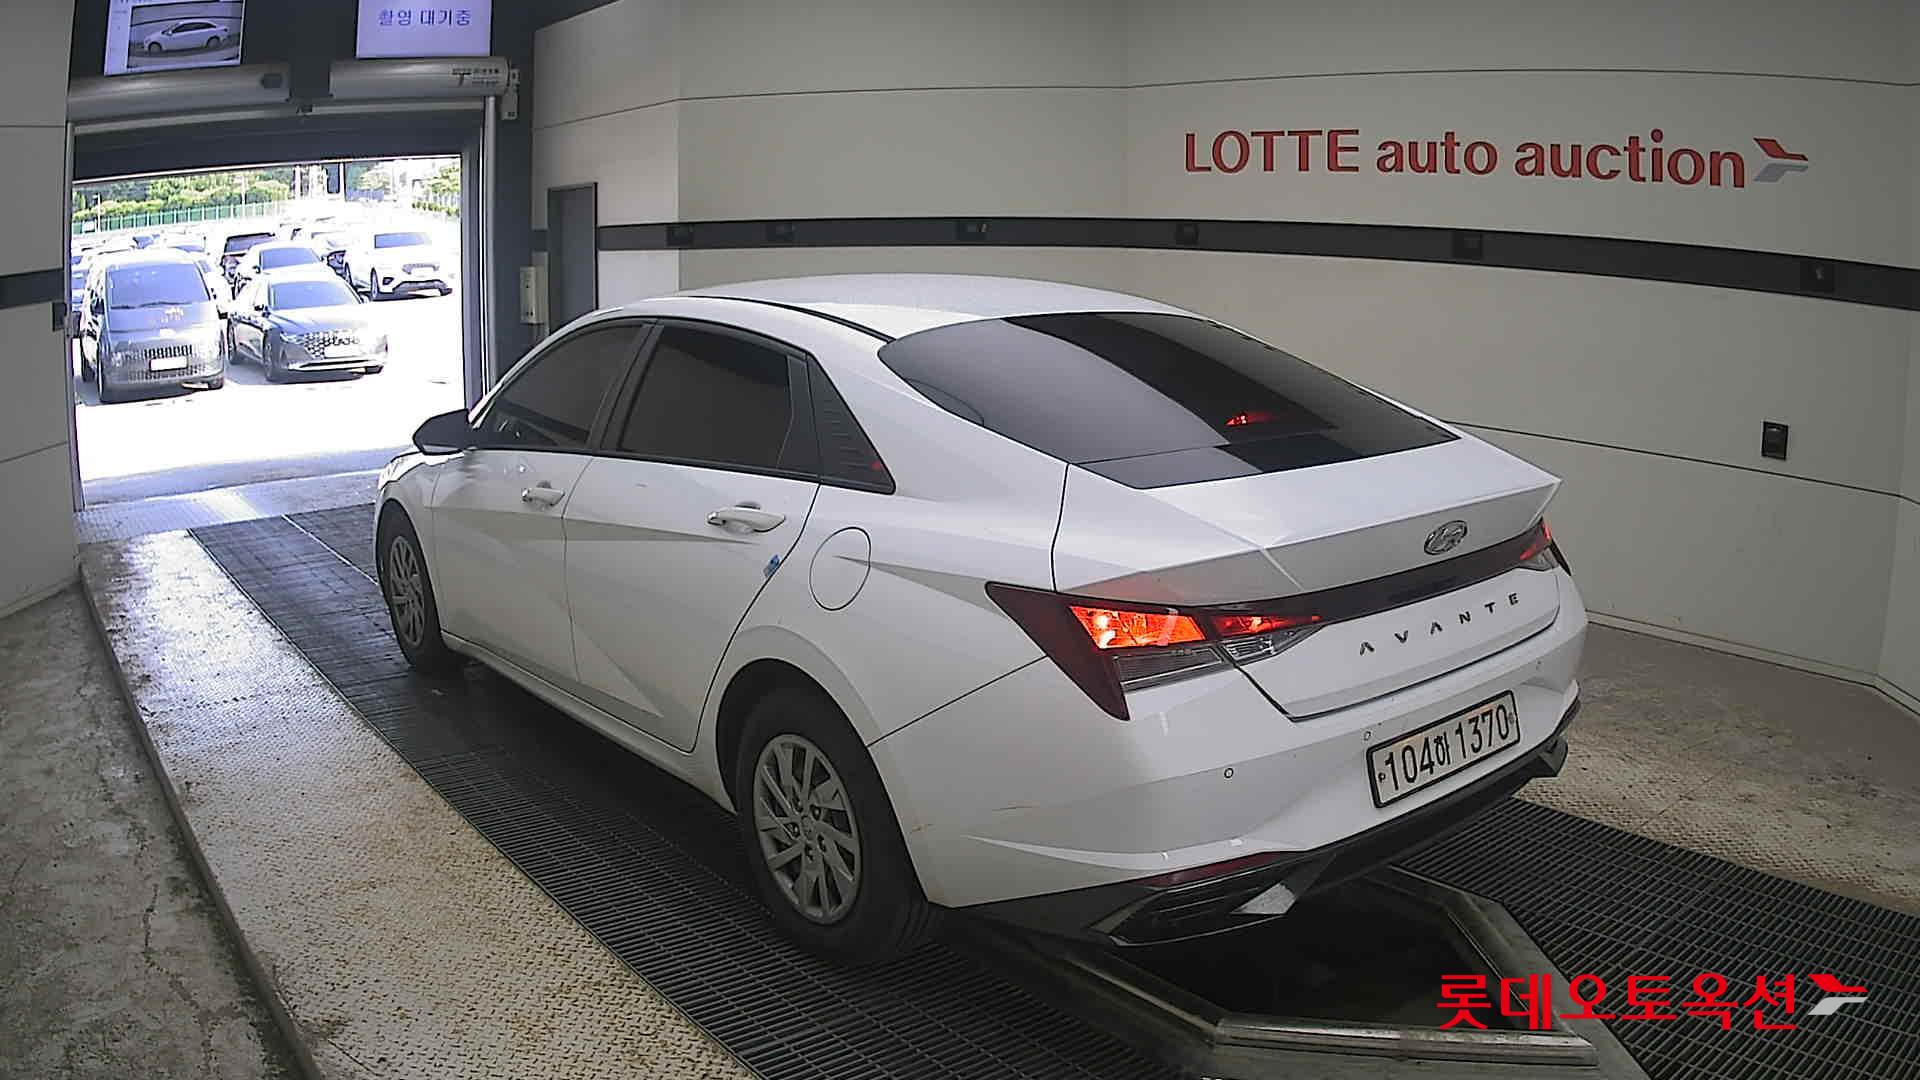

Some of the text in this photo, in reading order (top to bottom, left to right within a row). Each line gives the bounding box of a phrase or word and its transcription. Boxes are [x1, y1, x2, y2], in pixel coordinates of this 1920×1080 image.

[420, 9, 471, 26] 대기중
[1185, 128, 1745, 188] LOTTE auto auction
[1359, 592, 1519, 656] AVANTE
[1385, 704, 1510, 791] 104하 1370
